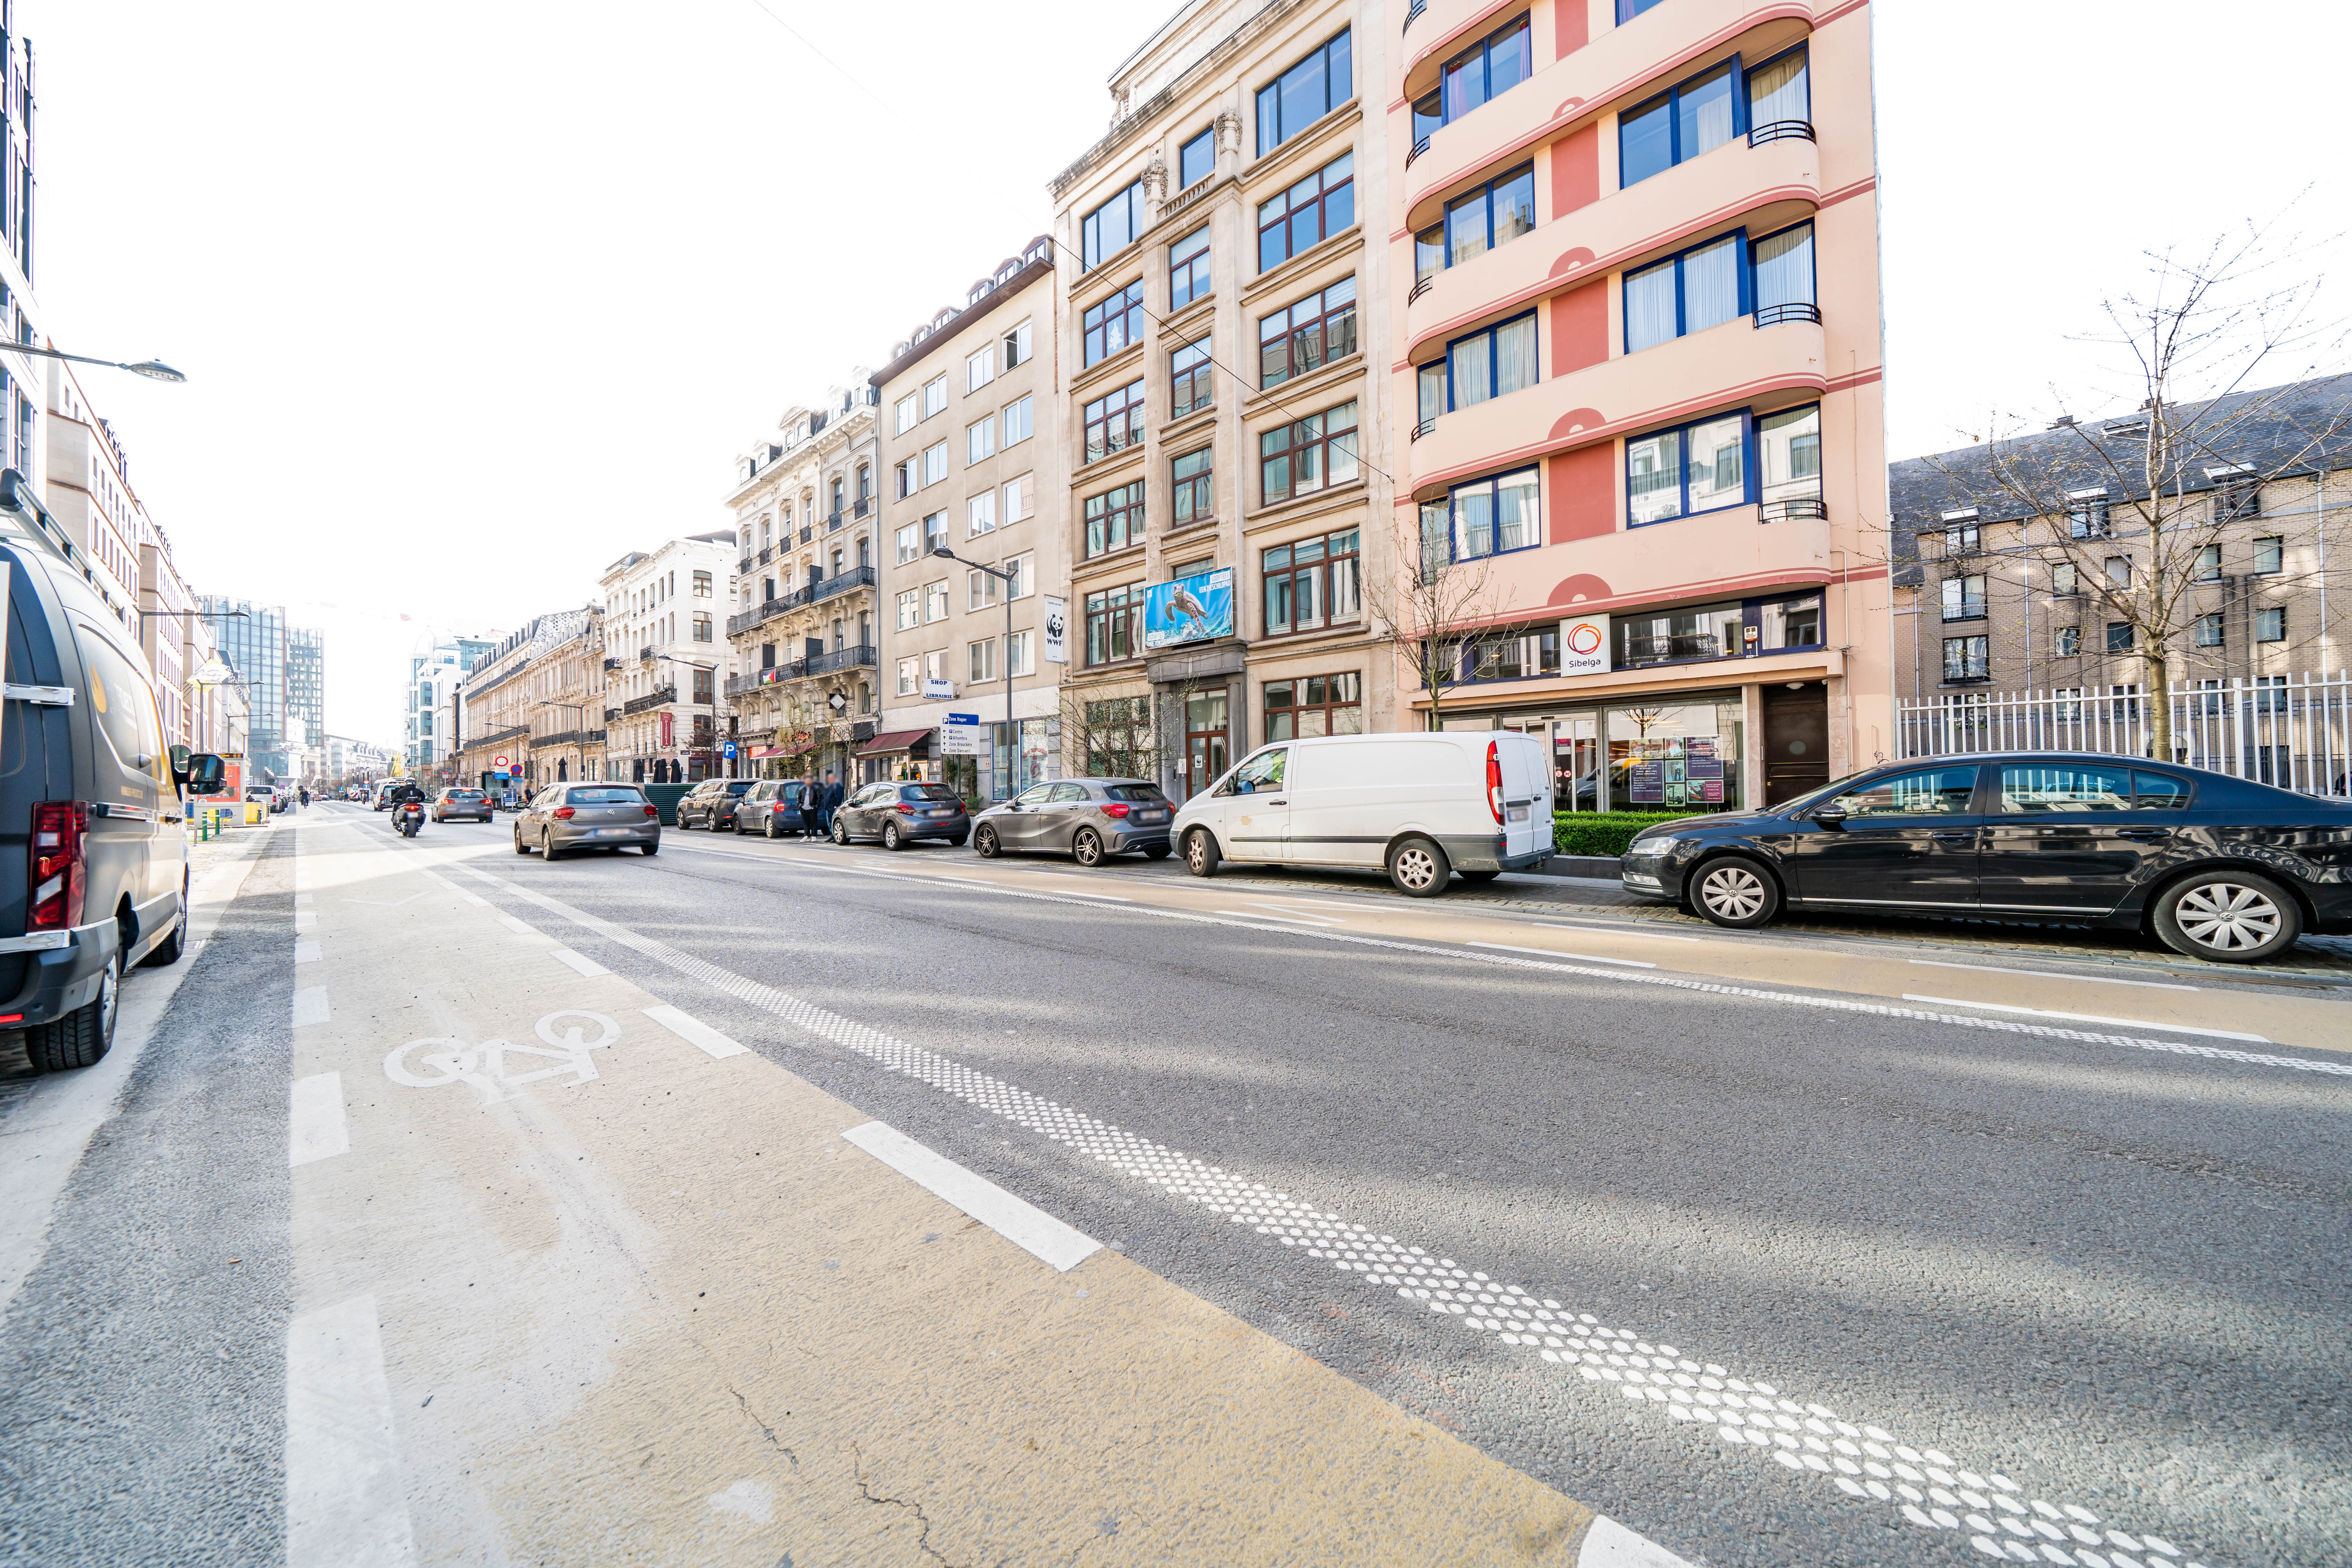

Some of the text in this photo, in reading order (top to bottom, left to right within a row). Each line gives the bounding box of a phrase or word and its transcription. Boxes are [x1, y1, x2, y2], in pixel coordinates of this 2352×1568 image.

[1211, 572, 1229, 582] ADOPTEER
[1047, 638, 1063, 646] WWF
[1569, 659, 1600, 668] Sibelga
[725, 744, 735, 756] P
